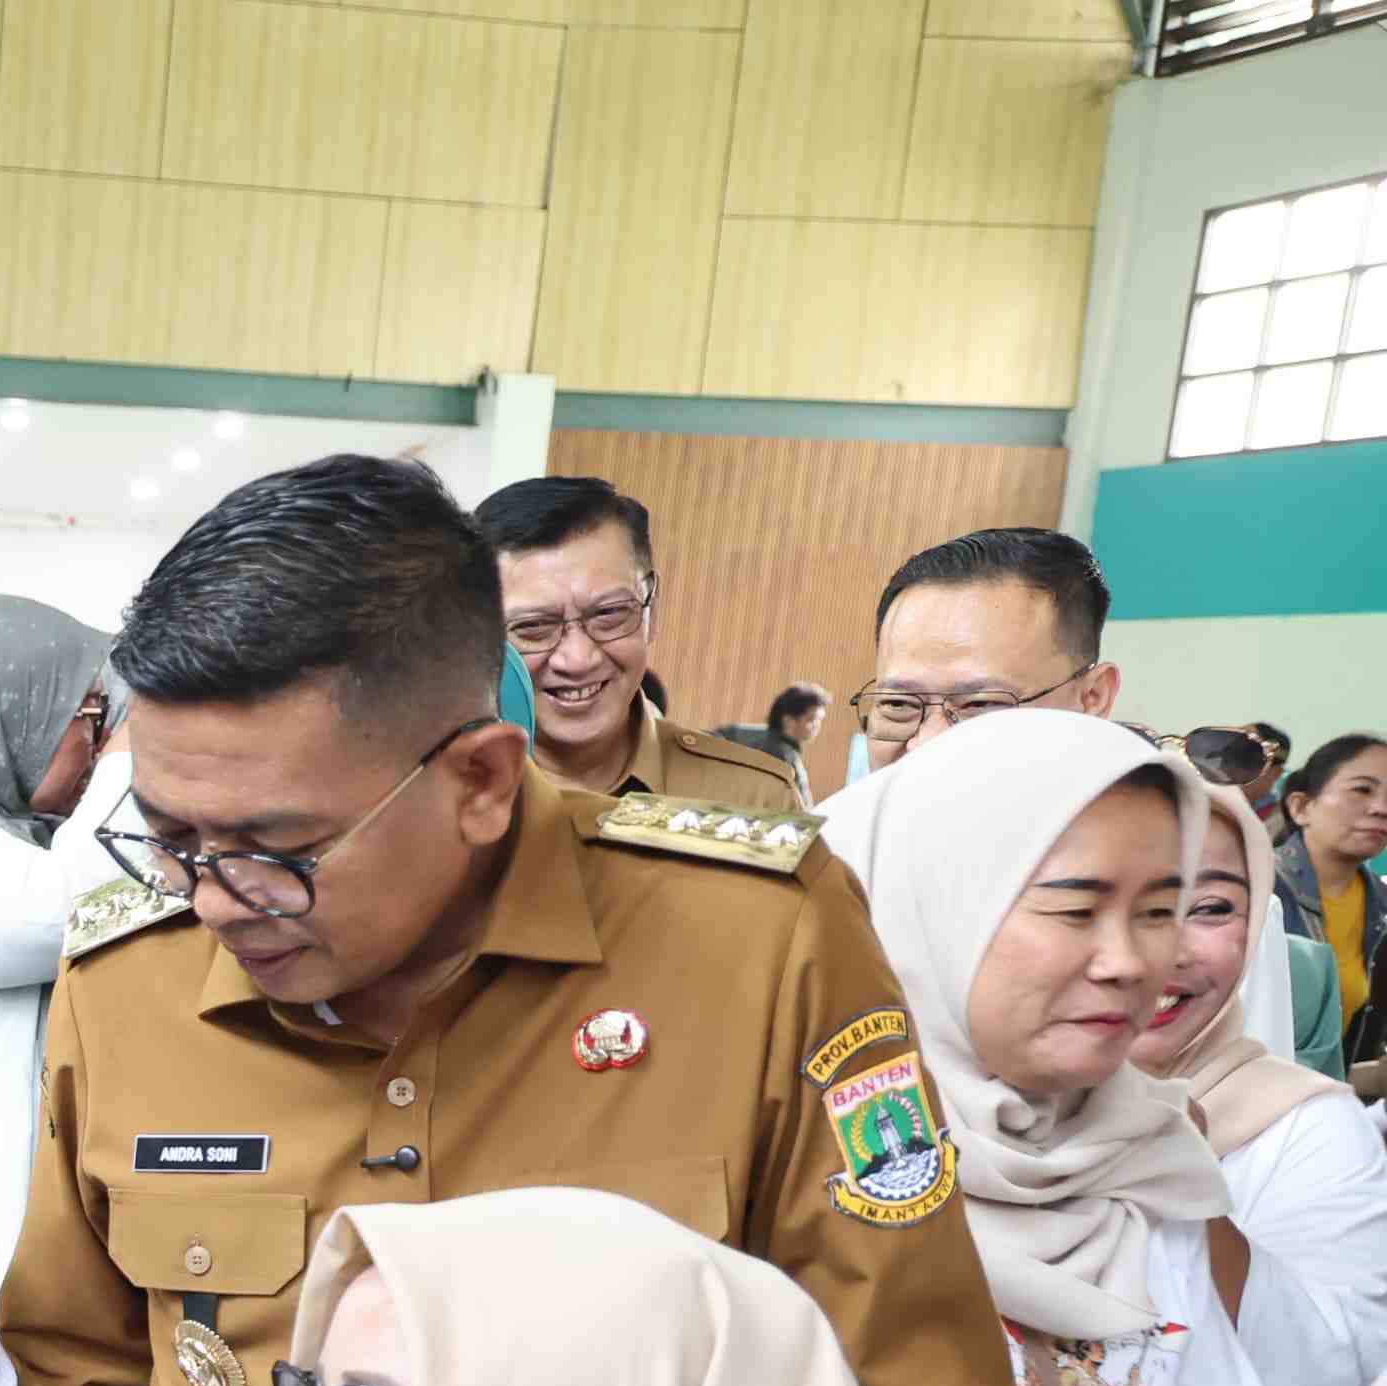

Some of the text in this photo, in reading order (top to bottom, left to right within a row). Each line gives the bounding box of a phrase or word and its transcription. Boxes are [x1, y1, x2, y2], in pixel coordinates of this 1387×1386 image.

[833, 1062, 912, 1107] BANTEN
[160, 1147, 238, 1162] ANDRA SONI
